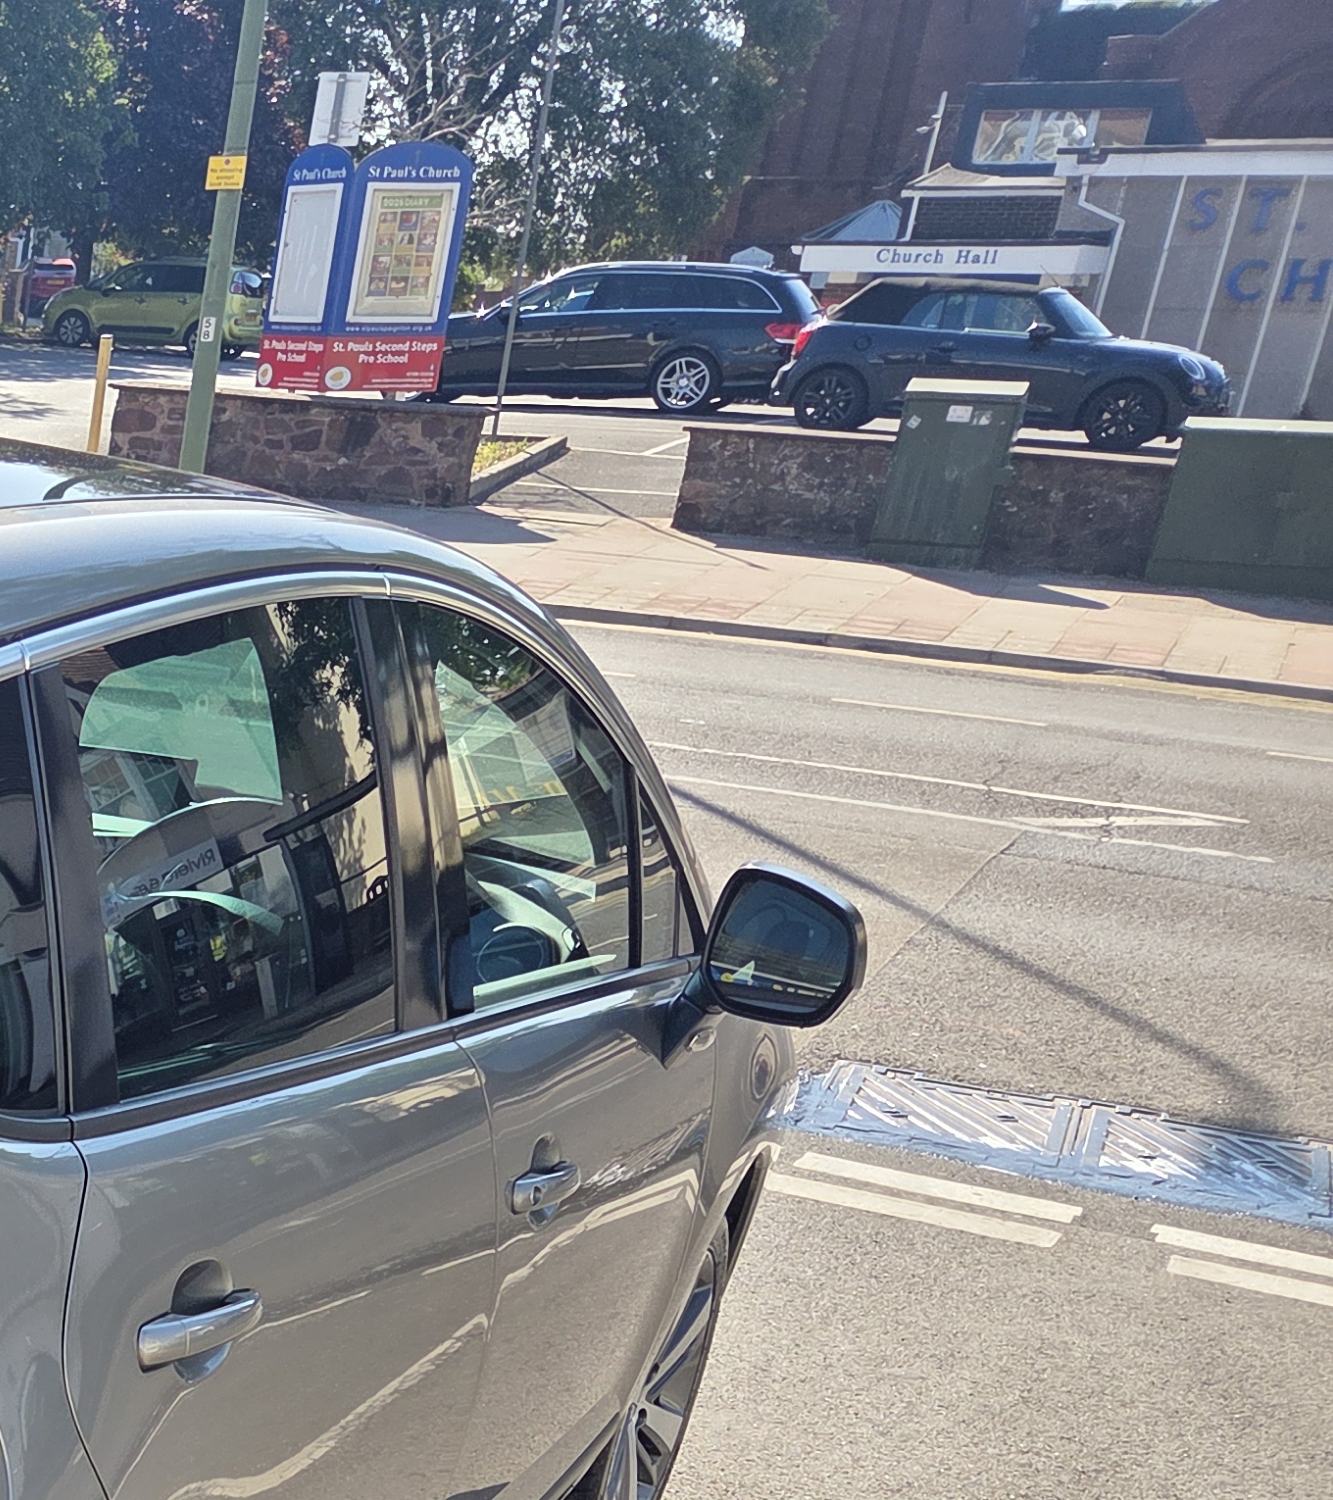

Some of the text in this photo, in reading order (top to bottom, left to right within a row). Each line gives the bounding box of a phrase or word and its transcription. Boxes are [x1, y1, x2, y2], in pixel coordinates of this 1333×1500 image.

[368, 166, 460, 178] St Paul's Church
[405, 197, 430, 207] DIARY
[876, 248, 998, 264] Church Hall
[333, 341, 438, 353] St. Pauls Second Steps
[358, 353, 409, 363] Pre School
